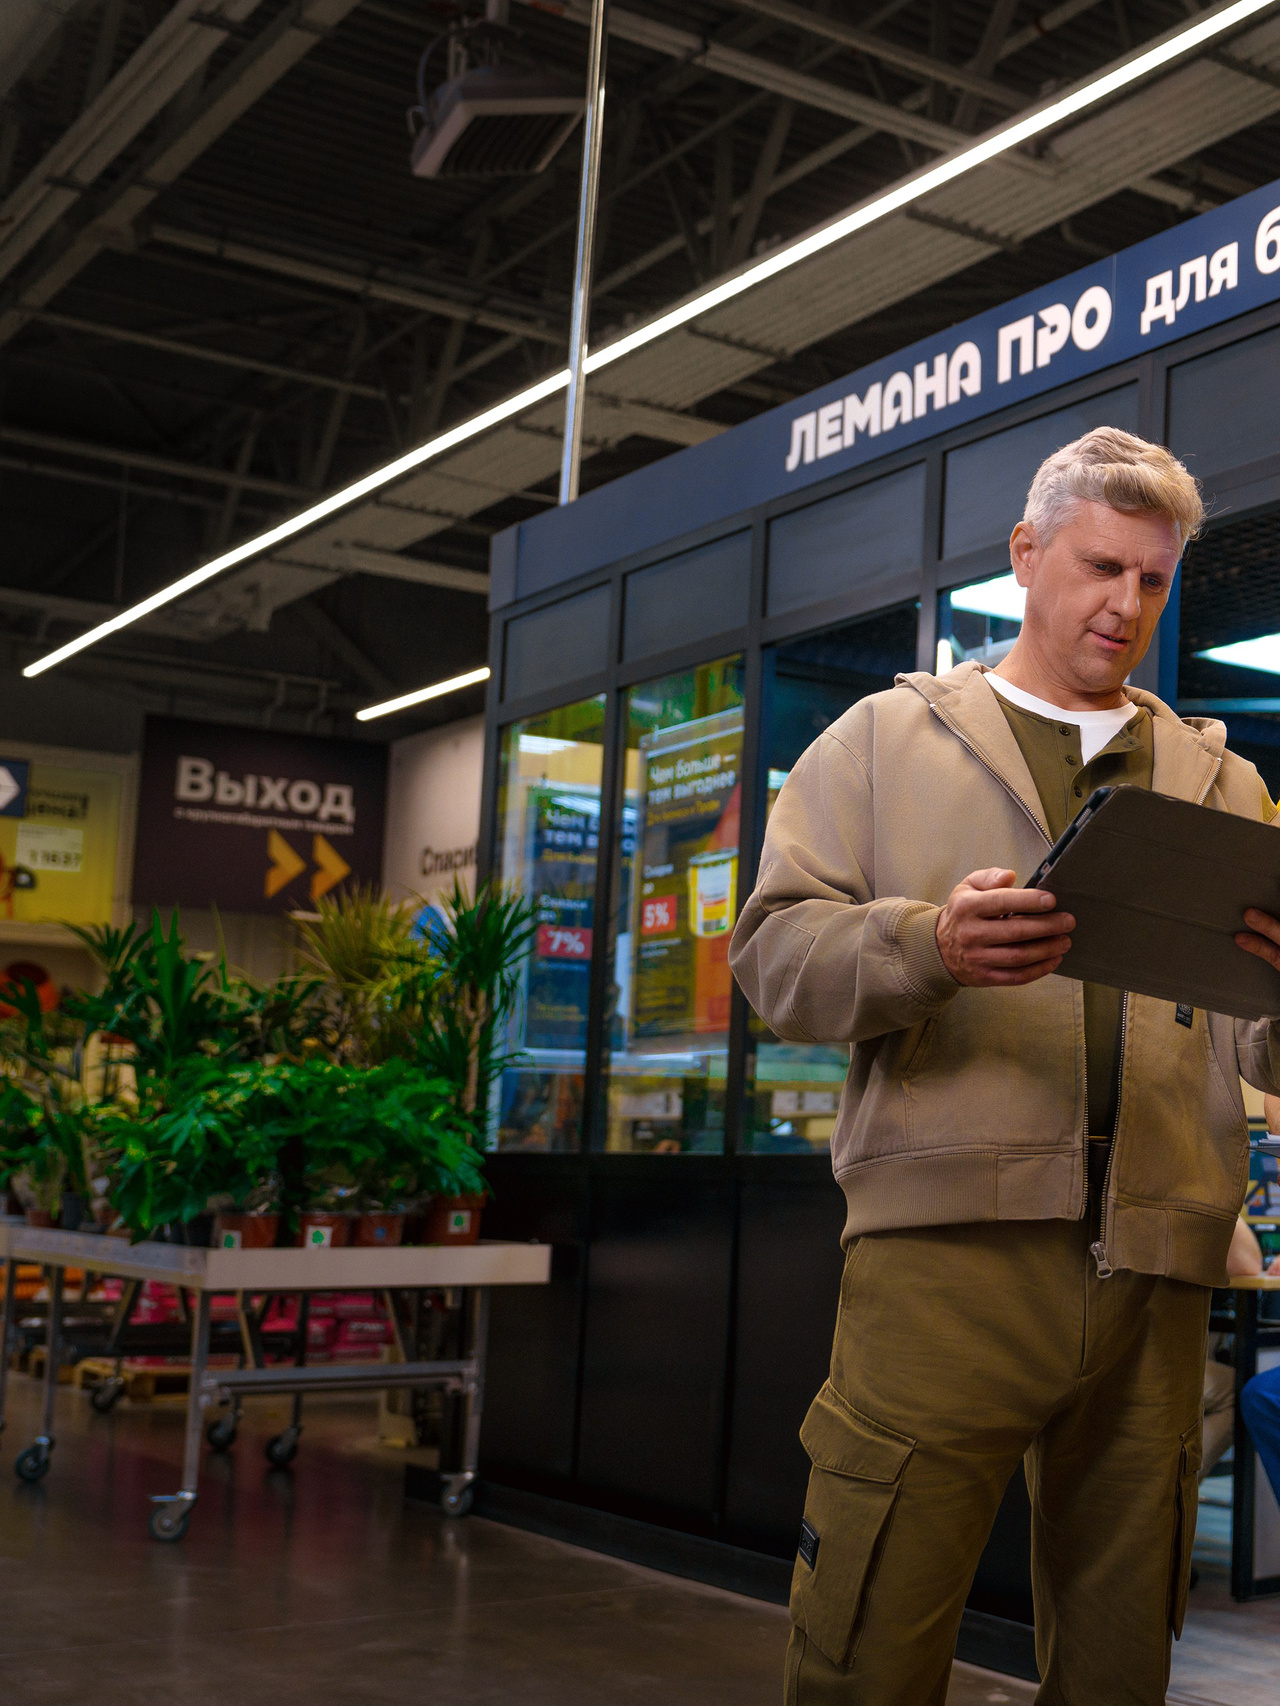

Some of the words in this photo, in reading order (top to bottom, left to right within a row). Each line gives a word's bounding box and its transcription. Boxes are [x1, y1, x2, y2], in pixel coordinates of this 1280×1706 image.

[785, 340, 982, 473] ЛЕМАНА
[997, 285, 1113, 384] ПРО
[1140, 241, 1239, 335] для
[650, 766, 674, 785] Чем
[676, 754, 721, 779] больше
[175, 755, 355, 824] Выход
[648, 786, 672, 805] тем
[674, 770, 736, 799] выгоднее
[546, 809, 586, 829] Чем
[544, 829, 582, 846] тем
[644, 901, 671, 928] 5%
[547, 930, 586, 955] 7%
